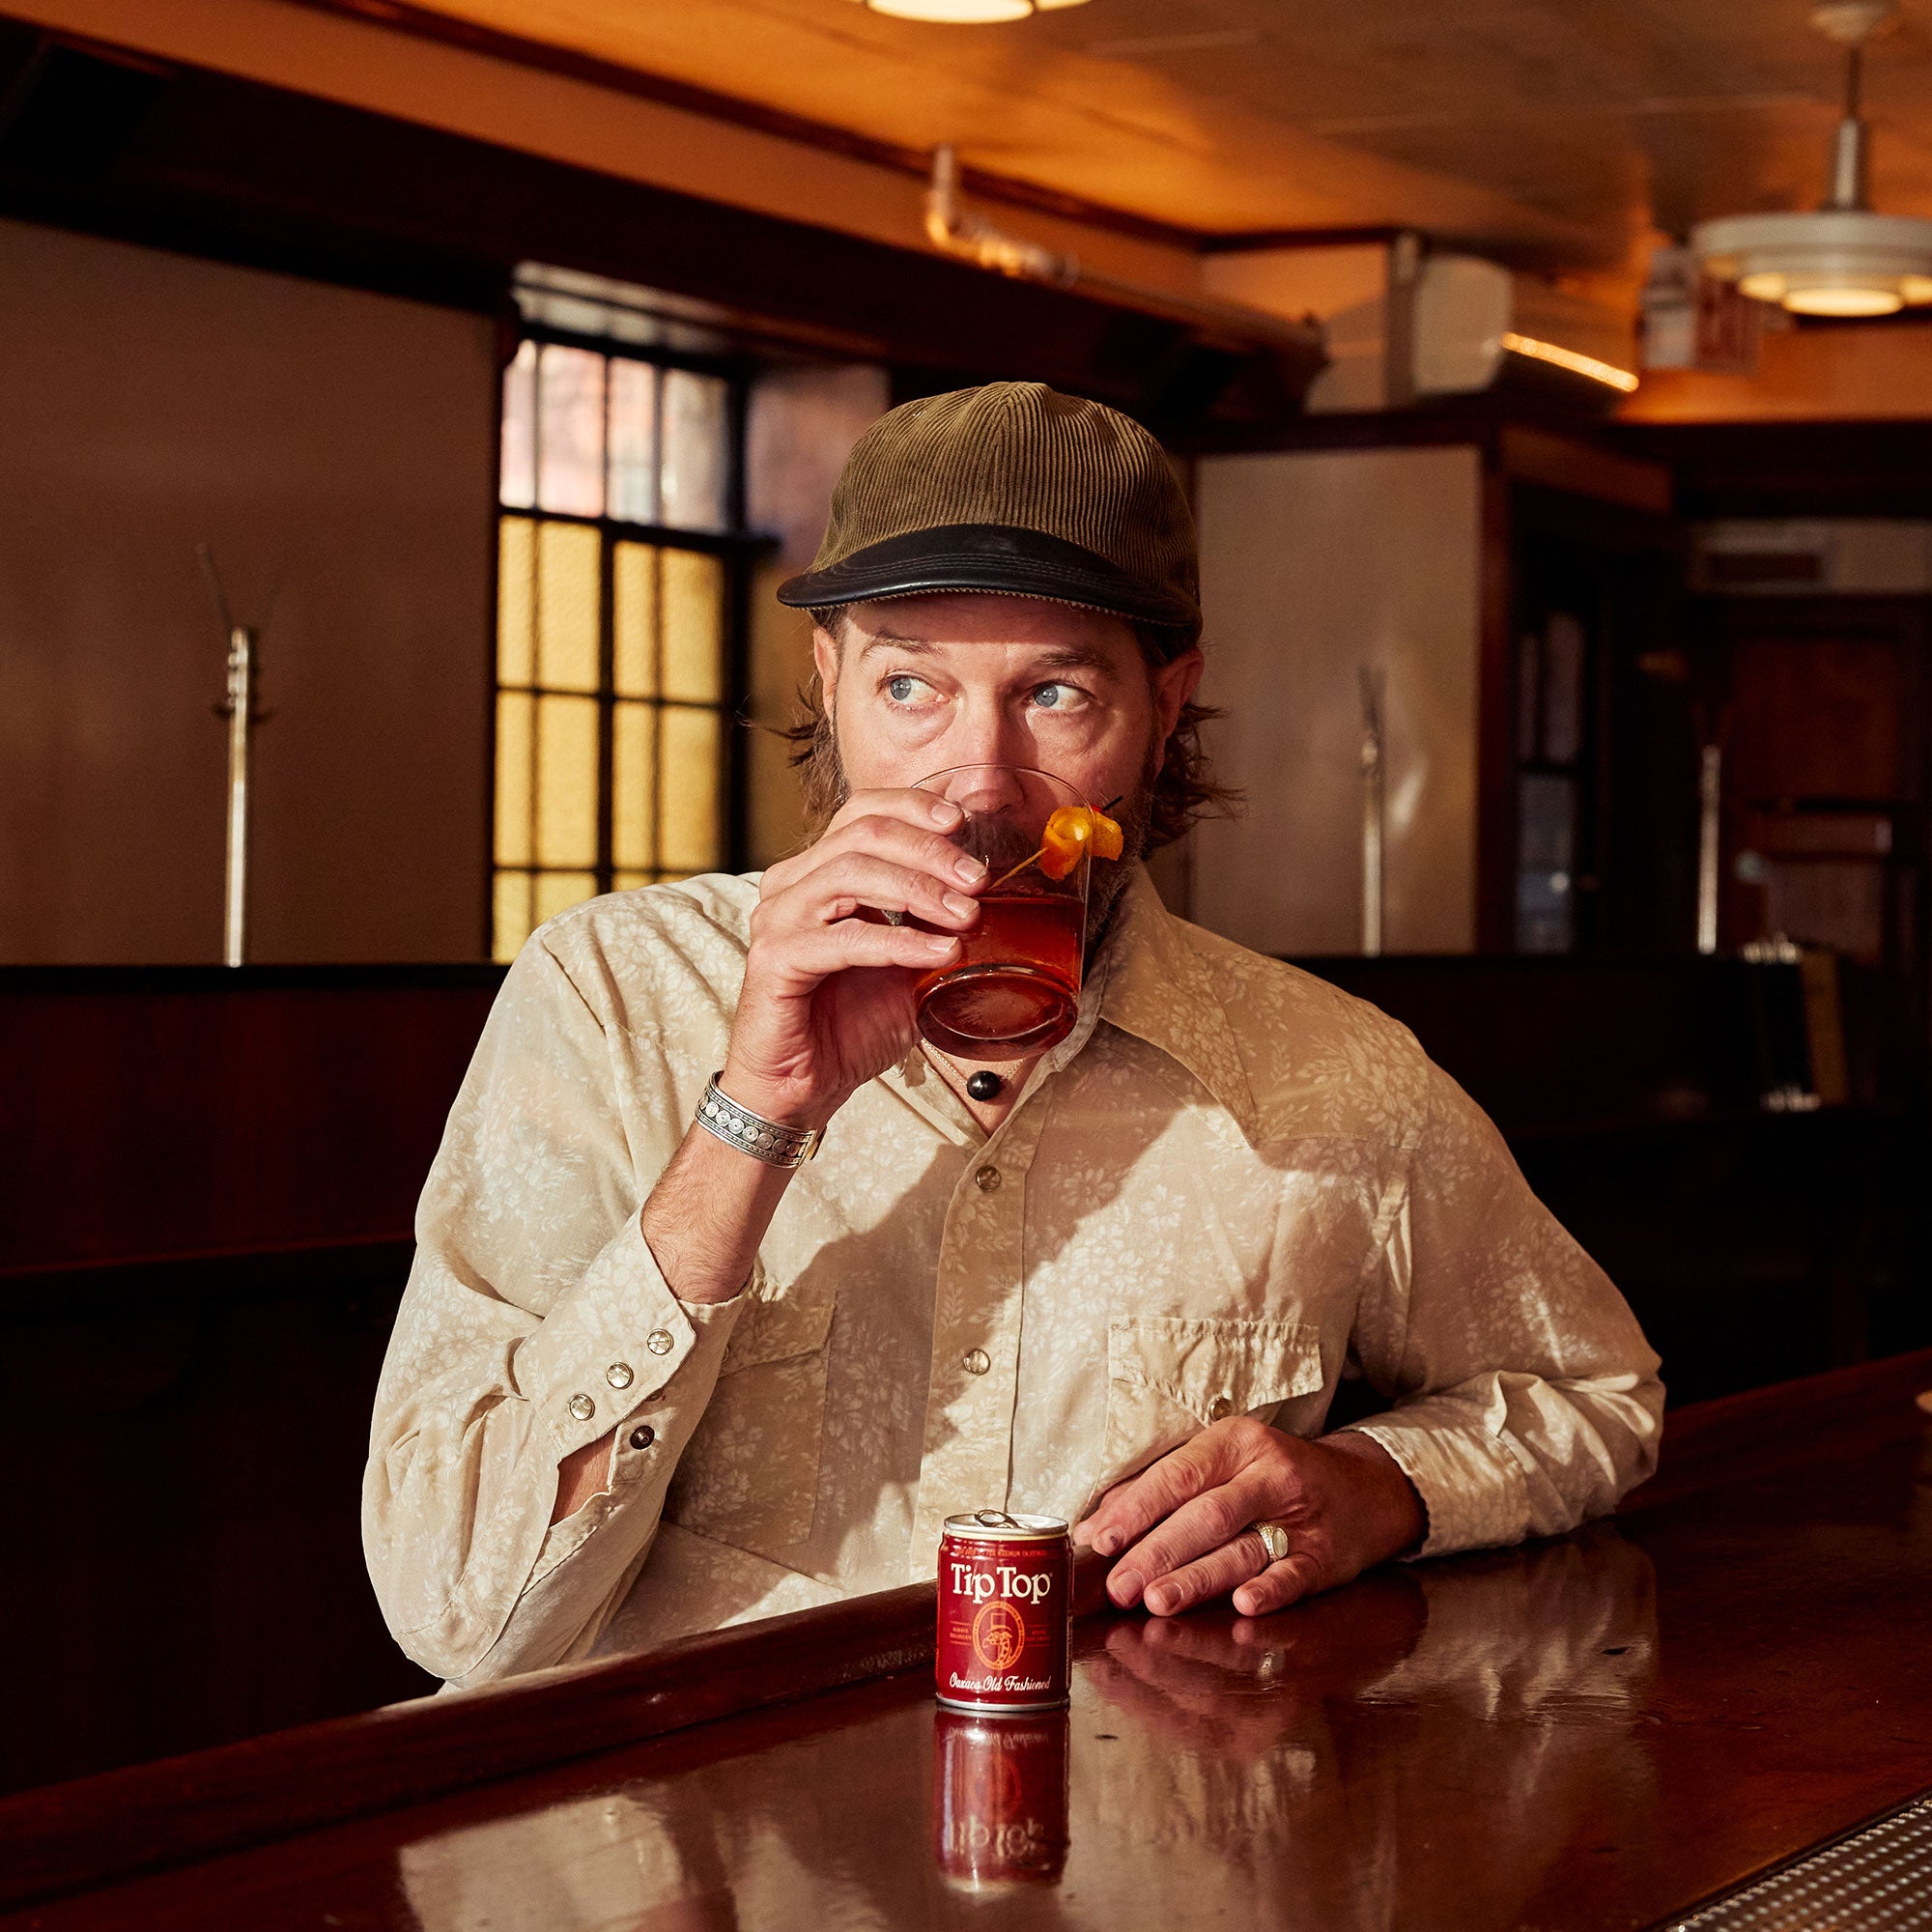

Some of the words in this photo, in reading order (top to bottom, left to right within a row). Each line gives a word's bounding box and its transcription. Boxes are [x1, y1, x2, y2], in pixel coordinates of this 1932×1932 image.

[951, 1563, 995, 1604] Tip
[996, 1567, 1051, 1604] Top
[949, 1671, 981, 1690] Oaxaca
[982, 1675, 1003, 1691] Old
[1004, 1675, 1052, 1691] Fashioned
